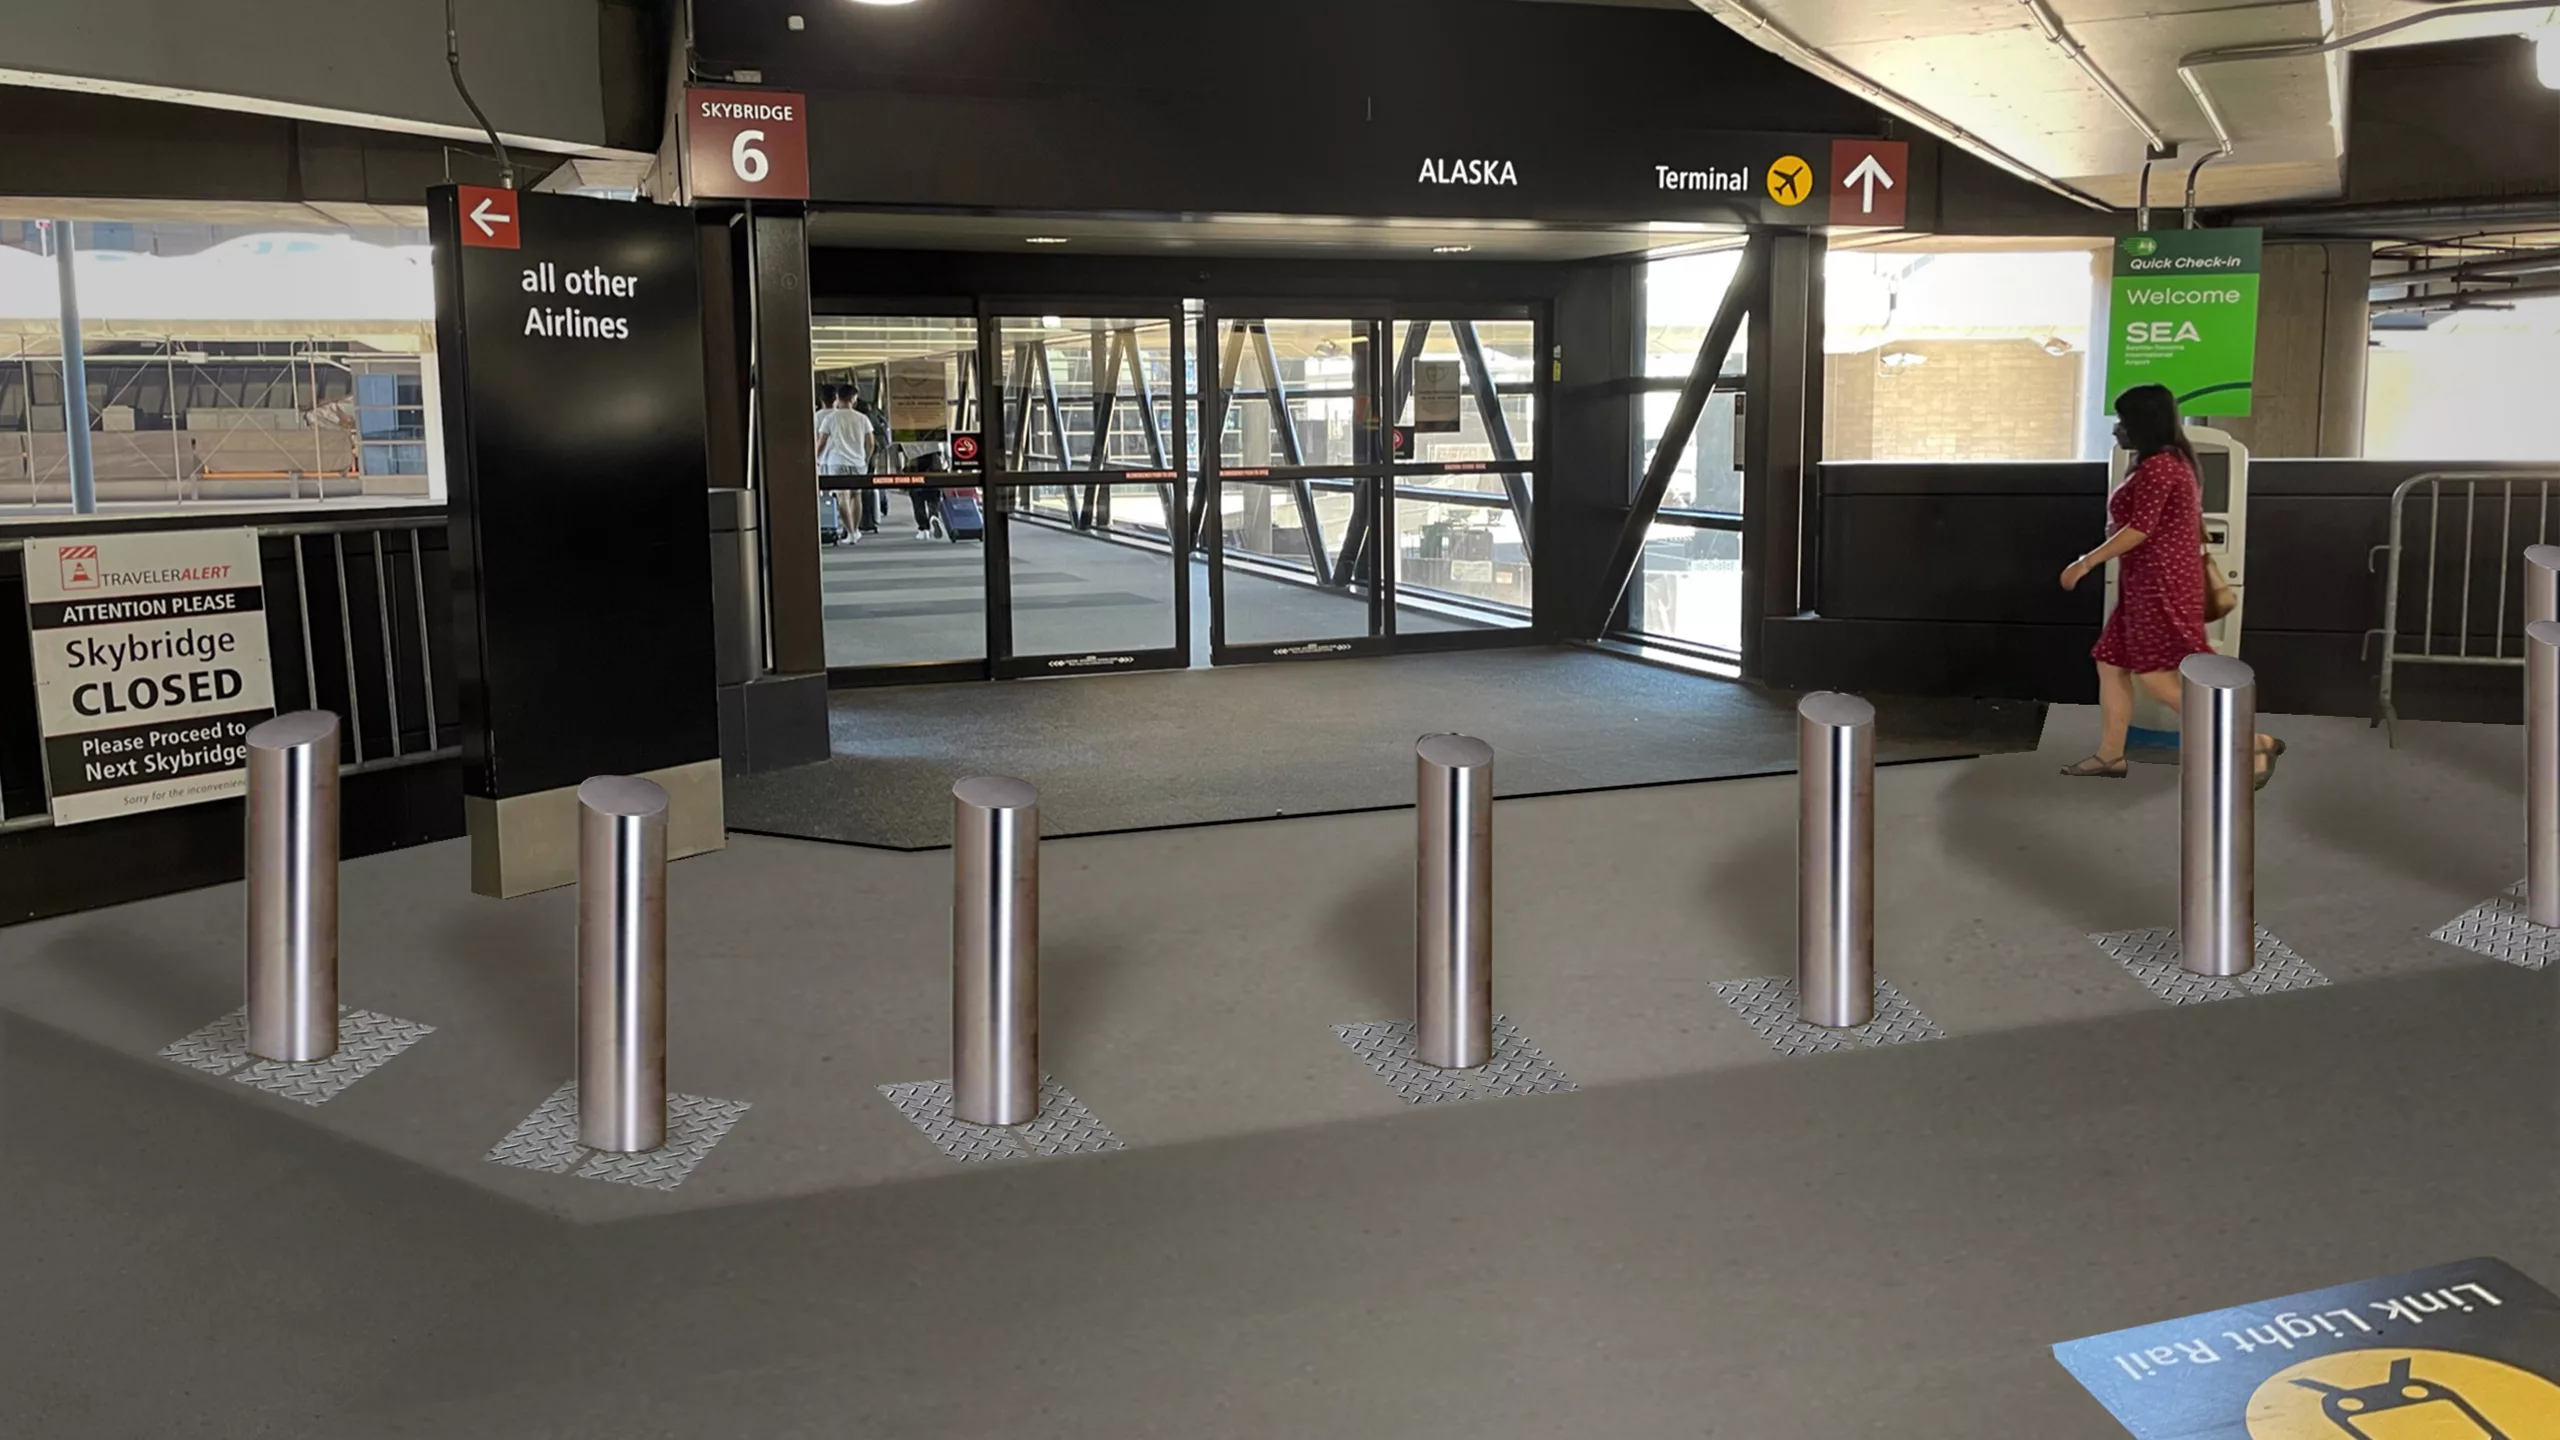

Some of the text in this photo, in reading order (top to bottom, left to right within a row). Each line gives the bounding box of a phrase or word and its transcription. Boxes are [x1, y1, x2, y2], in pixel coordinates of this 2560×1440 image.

[701, 102, 793, 122] SKYBRIDGE
[731, 129, 769, 182] 6
[1418, 158, 1518, 186] ALASKA
[1655, 165, 1749, 191] Terminal
[2130, 256, 2241, 270] Quick Check-in
[522, 262, 638, 298] all other
[2126, 288, 2241, 305] Welcome
[524, 307, 629, 340] Airlines
[2126, 320, 2202, 343] SEA
[100, 565, 231, 587] TRAVELERALERT
[63, 593, 236, 623] ATTENTION PLEASE
[65, 628, 235, 672] Skybridge
[72, 668, 243, 717] CLOSED
[82, 718, 246, 757] Please Proceed to
[85, 744, 247, 781] Next Skybridge
[123, 780, 247, 806] Sorry for the inconvenienc
[2114, 1282, 2505, 1381] Link Light Rail
